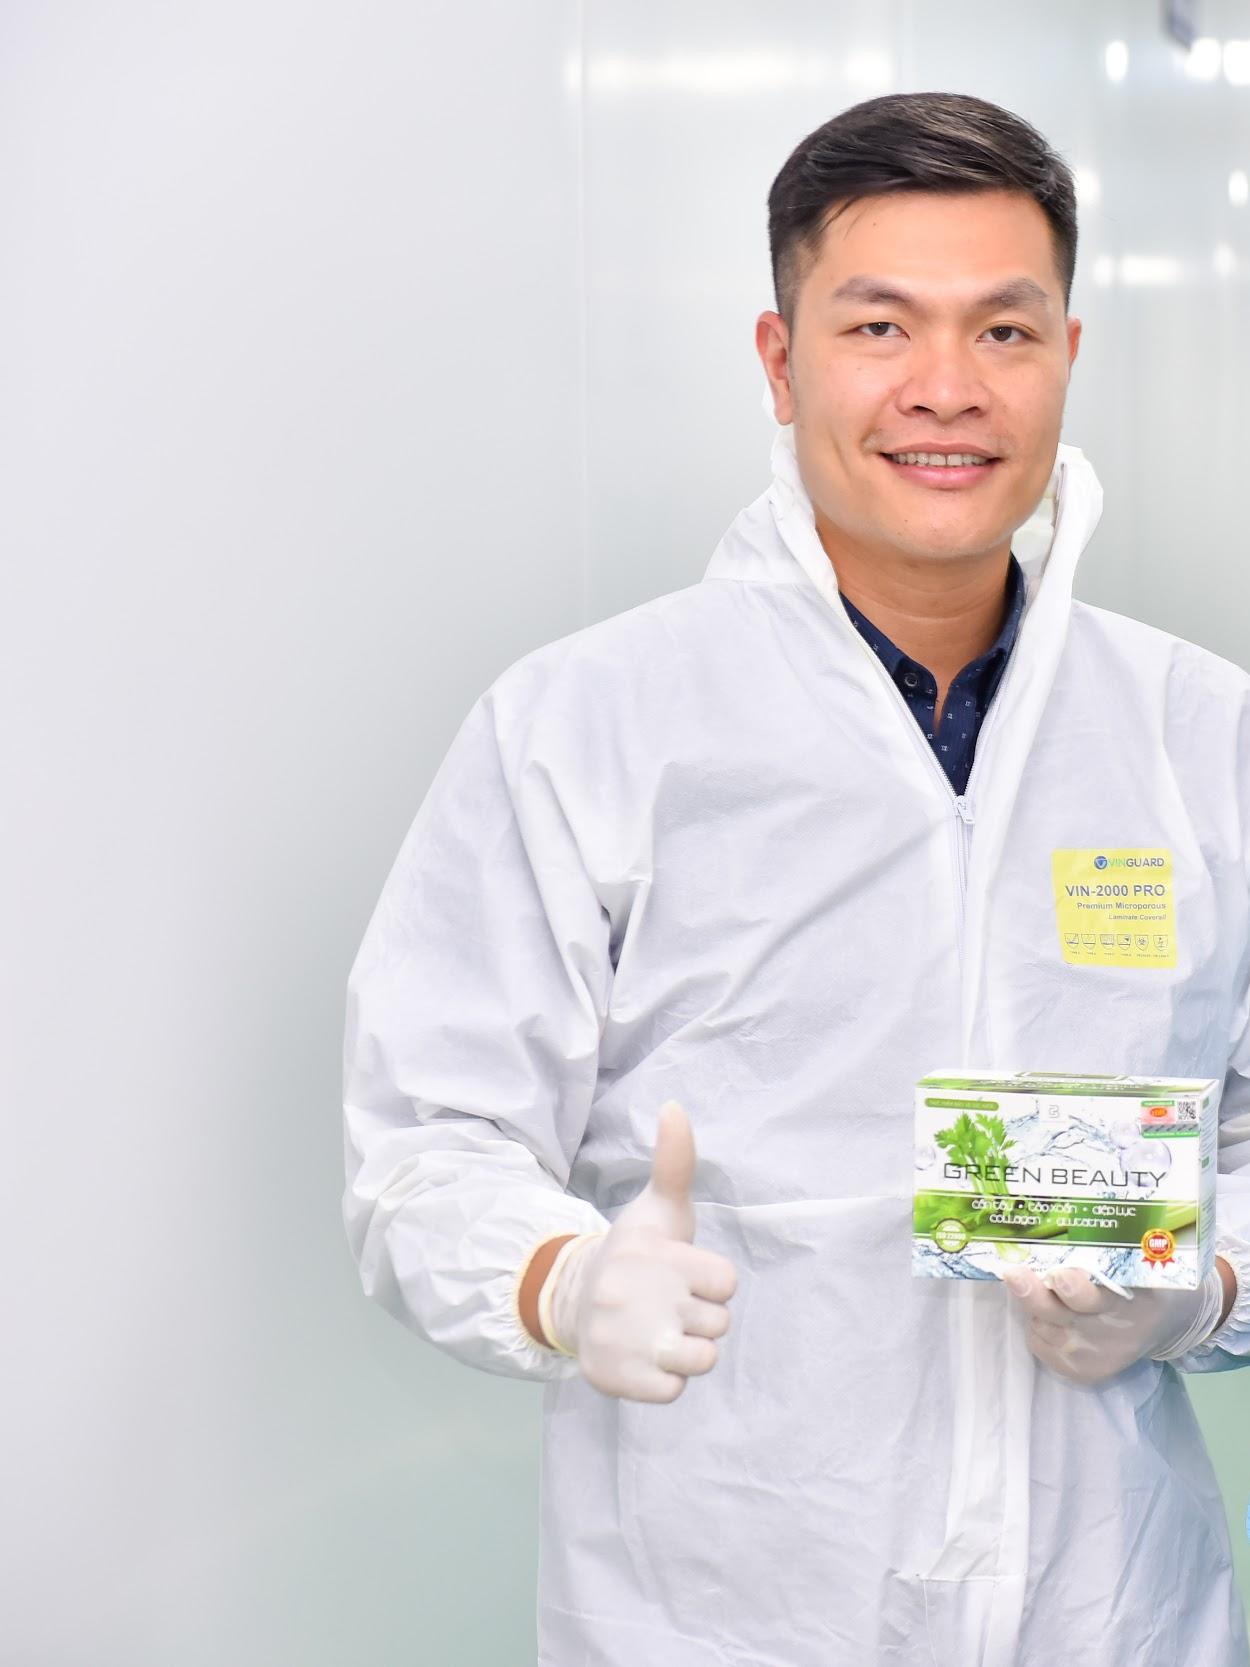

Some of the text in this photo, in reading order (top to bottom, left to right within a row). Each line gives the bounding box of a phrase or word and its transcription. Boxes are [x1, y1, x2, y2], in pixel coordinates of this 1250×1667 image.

[1065, 884, 1166, 897] VIN-2000 PRO
[1077, 902, 1167, 911] Premium Microporous
[944, 1162, 1167, 1188] GREEN BEAUTY
[1148, 1238, 1169, 1249] GMP
